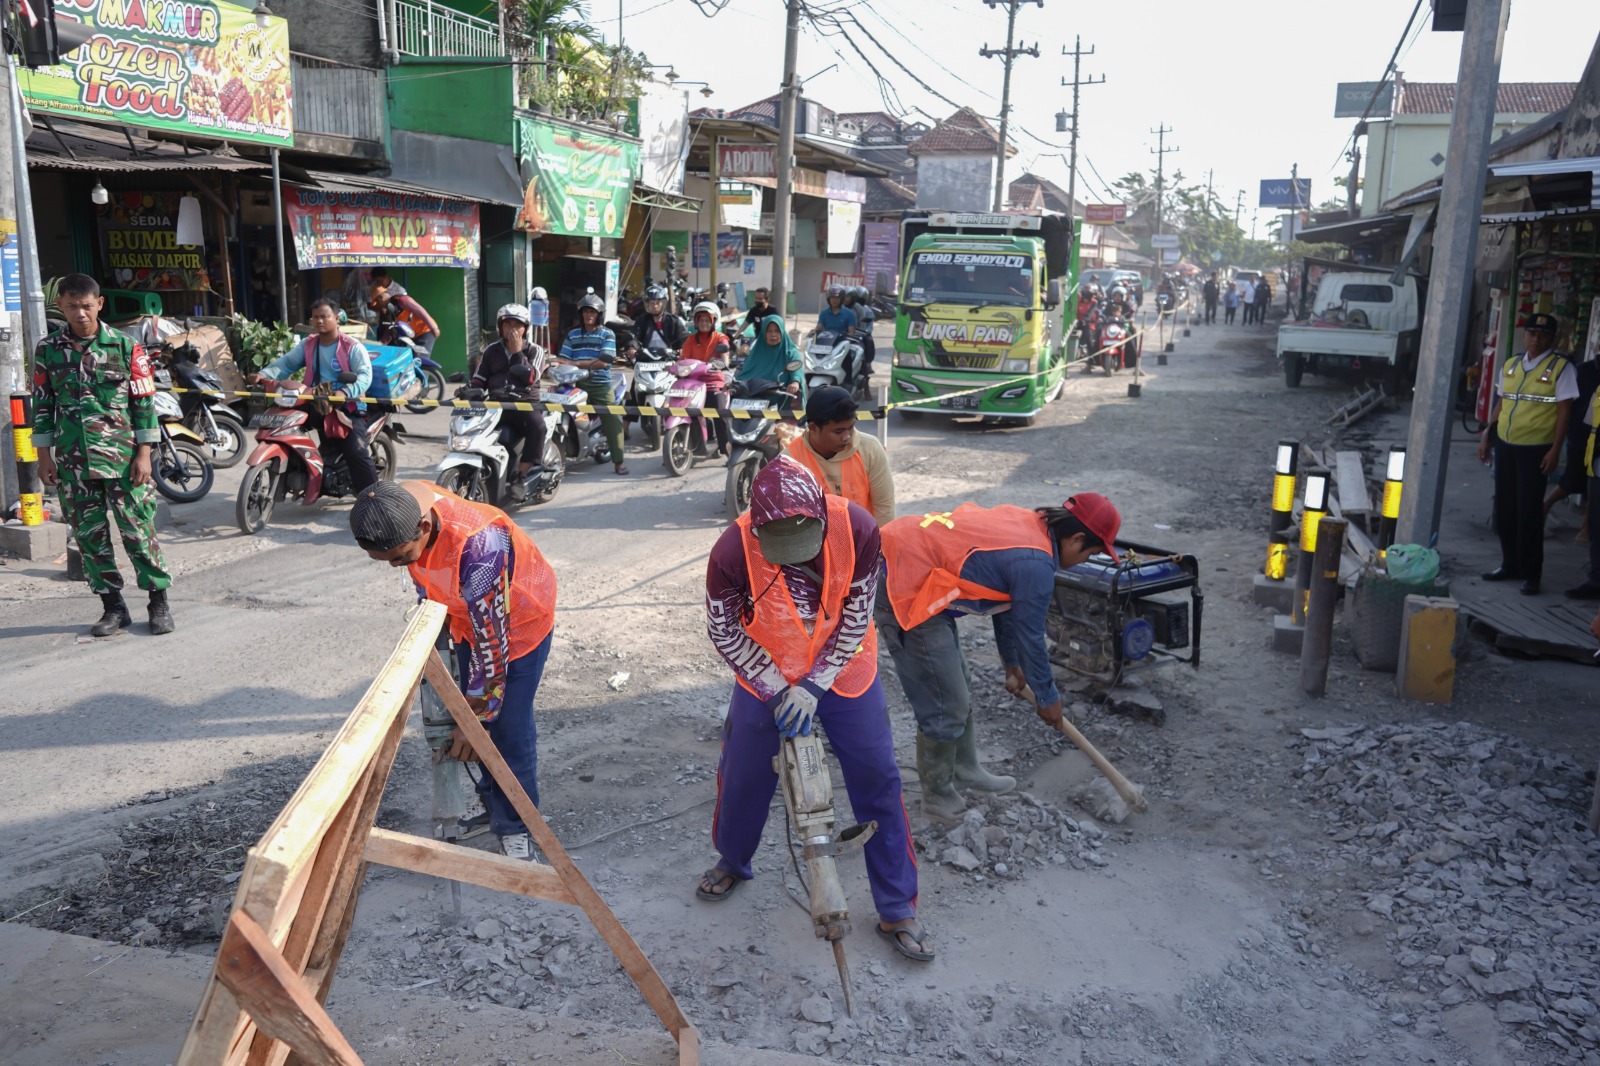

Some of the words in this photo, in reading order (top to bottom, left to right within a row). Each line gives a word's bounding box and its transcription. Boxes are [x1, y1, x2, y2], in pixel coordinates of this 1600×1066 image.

[100, 0, 217, 41] MAKMUR
[79, 62, 183, 117] Food
[722, 150, 776, 173] APOTIK
[296, 190, 338, 206] TOKO
[340, 192, 393, 209] PLASTIK
[130, 215, 171, 226] SEDIA
[107, 230, 197, 250] BUMB
[108, 253, 154, 268] MASAK
[156, 253, 202, 269] DAPUR
[907, 320, 969, 342] BUNGA
